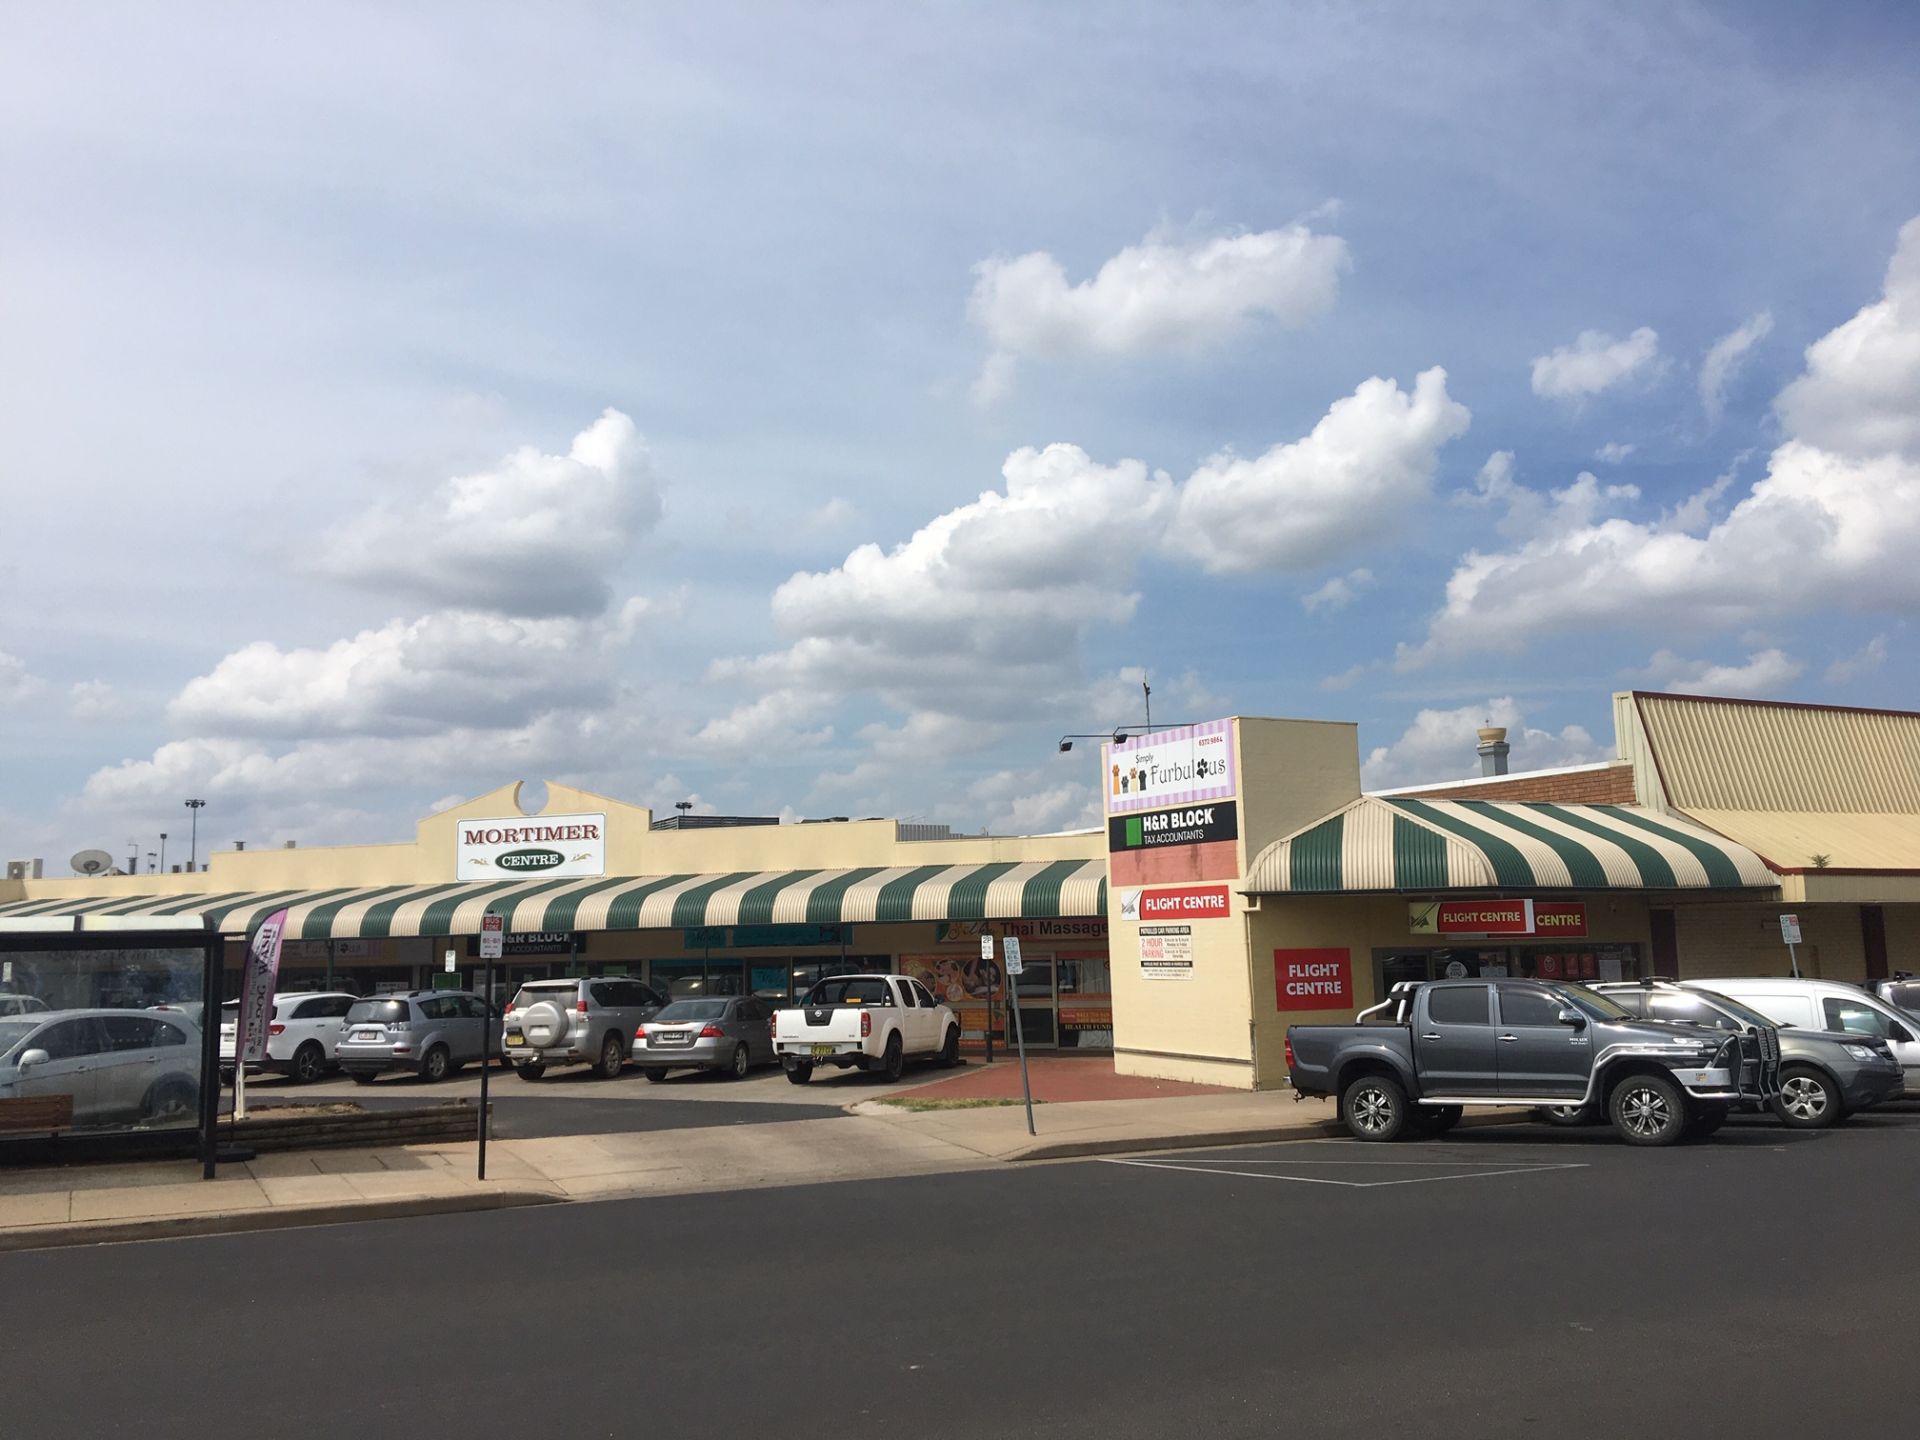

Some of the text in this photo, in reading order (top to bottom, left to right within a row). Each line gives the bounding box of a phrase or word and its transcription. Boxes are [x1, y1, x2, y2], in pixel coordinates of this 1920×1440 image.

[1135, 753, 1154, 764] Simply
[1151, 759, 1226, 785] Furbulus
[1143, 808, 1214, 832] H&R BLOCK
[464, 824, 600, 846] MORTIMER
[1144, 829, 1204, 845] TAX ACCOUNTANTS
[501, 854, 559, 867] CENTRE
[1145, 895, 1225, 911] FLIGHT CENTRE
[485, 917, 500, 925] BUS
[1443, 911, 1521, 922] FLIGHT CENTRE
[1536, 914, 1581, 926] CENTRE
[1001, 921, 1035, 935] Thai
[1039, 921, 1108, 937] Massage
[528, 932, 570, 943] BLOCK
[982, 936, 992, 944] 2P
[1146, 937, 1163, 947] HOUR
[256, 929, 272, 976] WASH
[1288, 963, 1339, 977] FLIGHT
[1286, 981, 1342, 995] CENTRE
